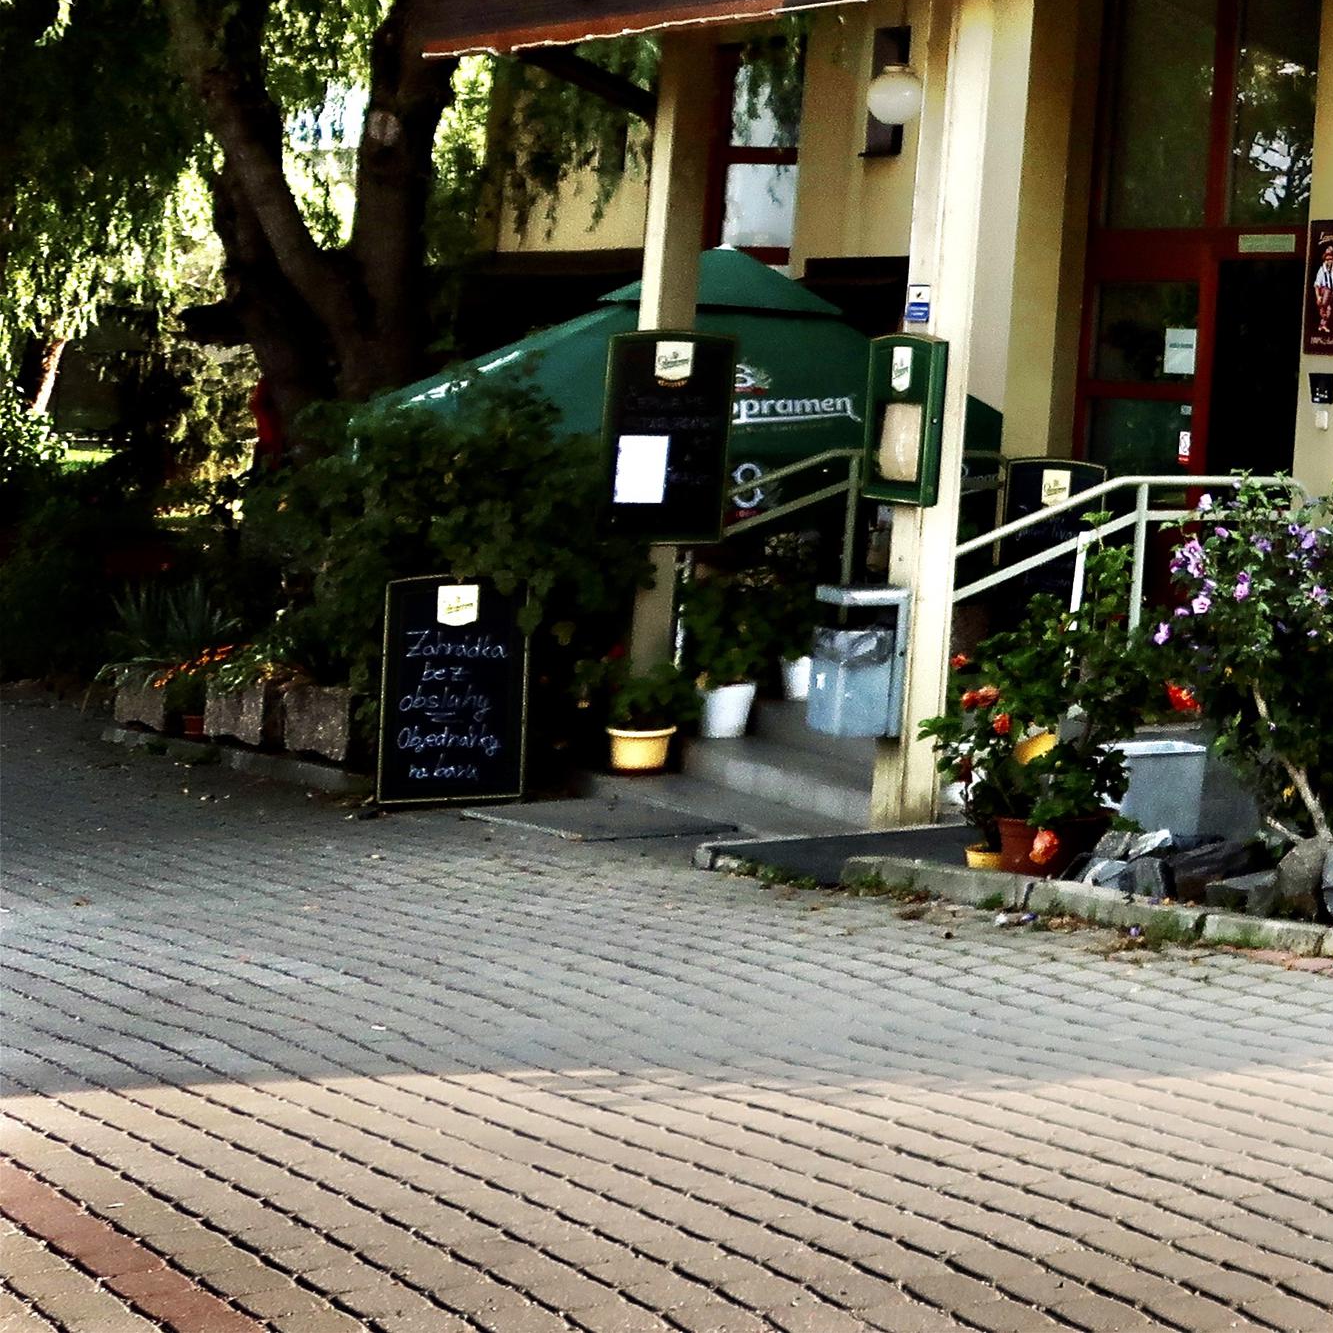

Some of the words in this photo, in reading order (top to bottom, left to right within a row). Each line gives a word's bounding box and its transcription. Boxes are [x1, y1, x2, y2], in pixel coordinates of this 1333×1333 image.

[731, 395, 862, 425] pramen
[405, 630, 508, 659] Zahrádka
[421, 661, 470, 682] bez
